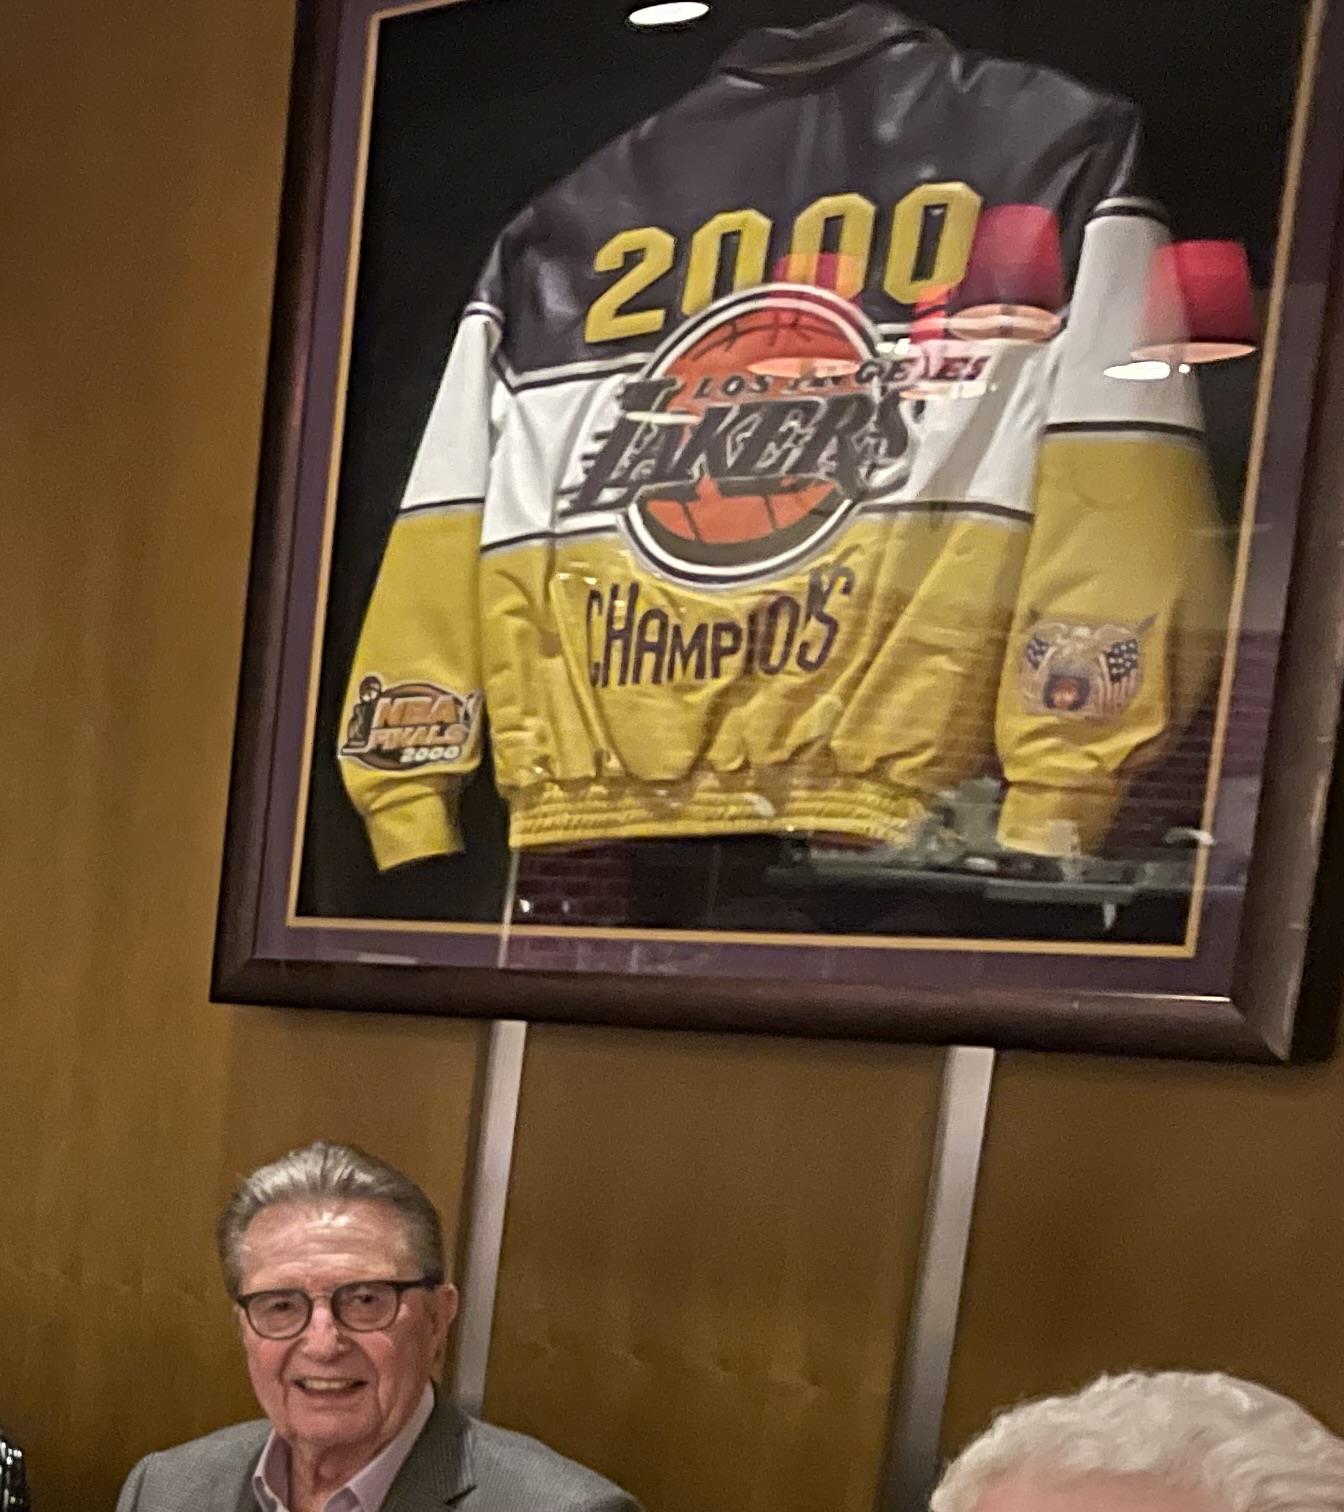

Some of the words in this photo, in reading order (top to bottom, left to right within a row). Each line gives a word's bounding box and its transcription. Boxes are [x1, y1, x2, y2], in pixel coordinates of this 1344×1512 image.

[583, 181, 983, 344] 2000
[692, 374, 772, 401] LOS
[372, 694, 462, 730] NBA
[369, 723, 471, 750] FINALS
[400, 745, 460, 764] 2000
